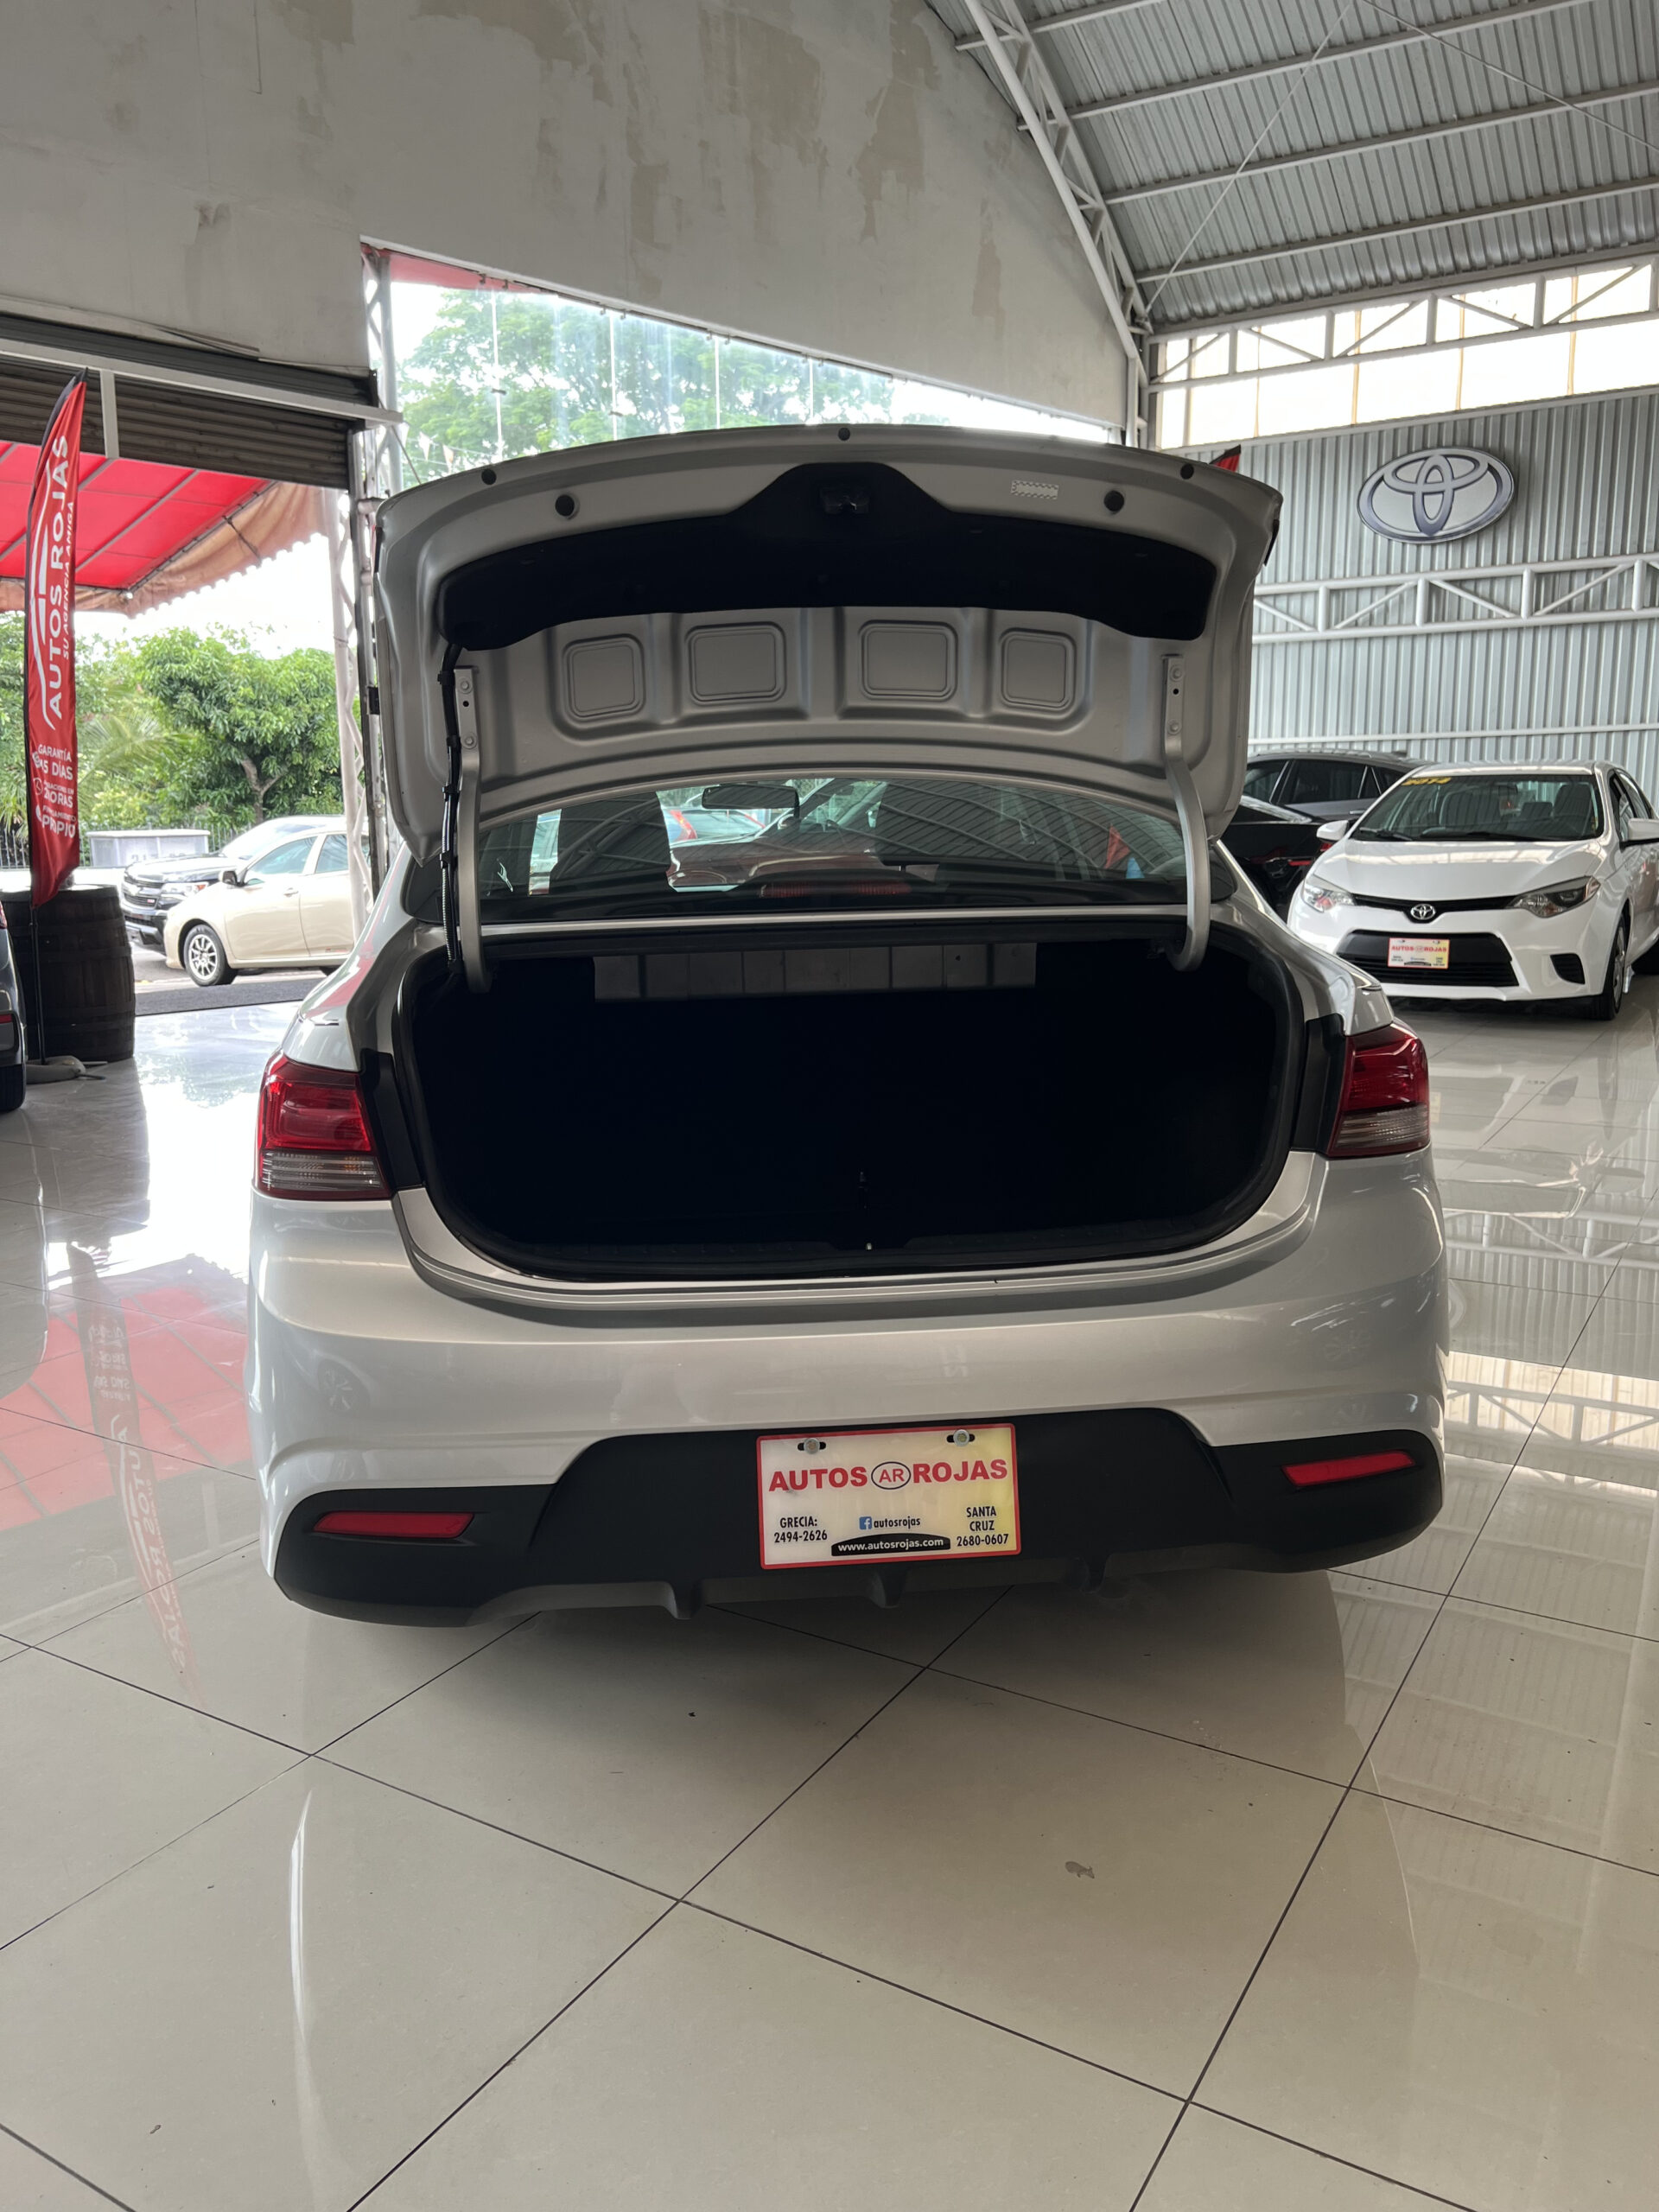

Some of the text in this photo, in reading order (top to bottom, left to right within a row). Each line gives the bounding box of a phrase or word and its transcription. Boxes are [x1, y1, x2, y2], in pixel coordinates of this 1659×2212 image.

[49, 435, 68, 720] AUTOS ROJAS
[62, 638, 69, 660] SU
[66, 501, 74, 556] AMIGA
[768, 1459, 1007, 1491] AUTOS AR ROJAS
[966, 1505, 997, 1518] SANTA
[779, 1516, 817, 1529] GRECIA:
[874, 1516, 920, 1529] autosrojas
[969, 1520, 995, 1532] CRUZ
[774, 1529, 828, 1543] 2494-2626
[957, 1533, 1009, 1548] 2680-0607
[837, 1538, 944, 1552] www.autosrojas.com
